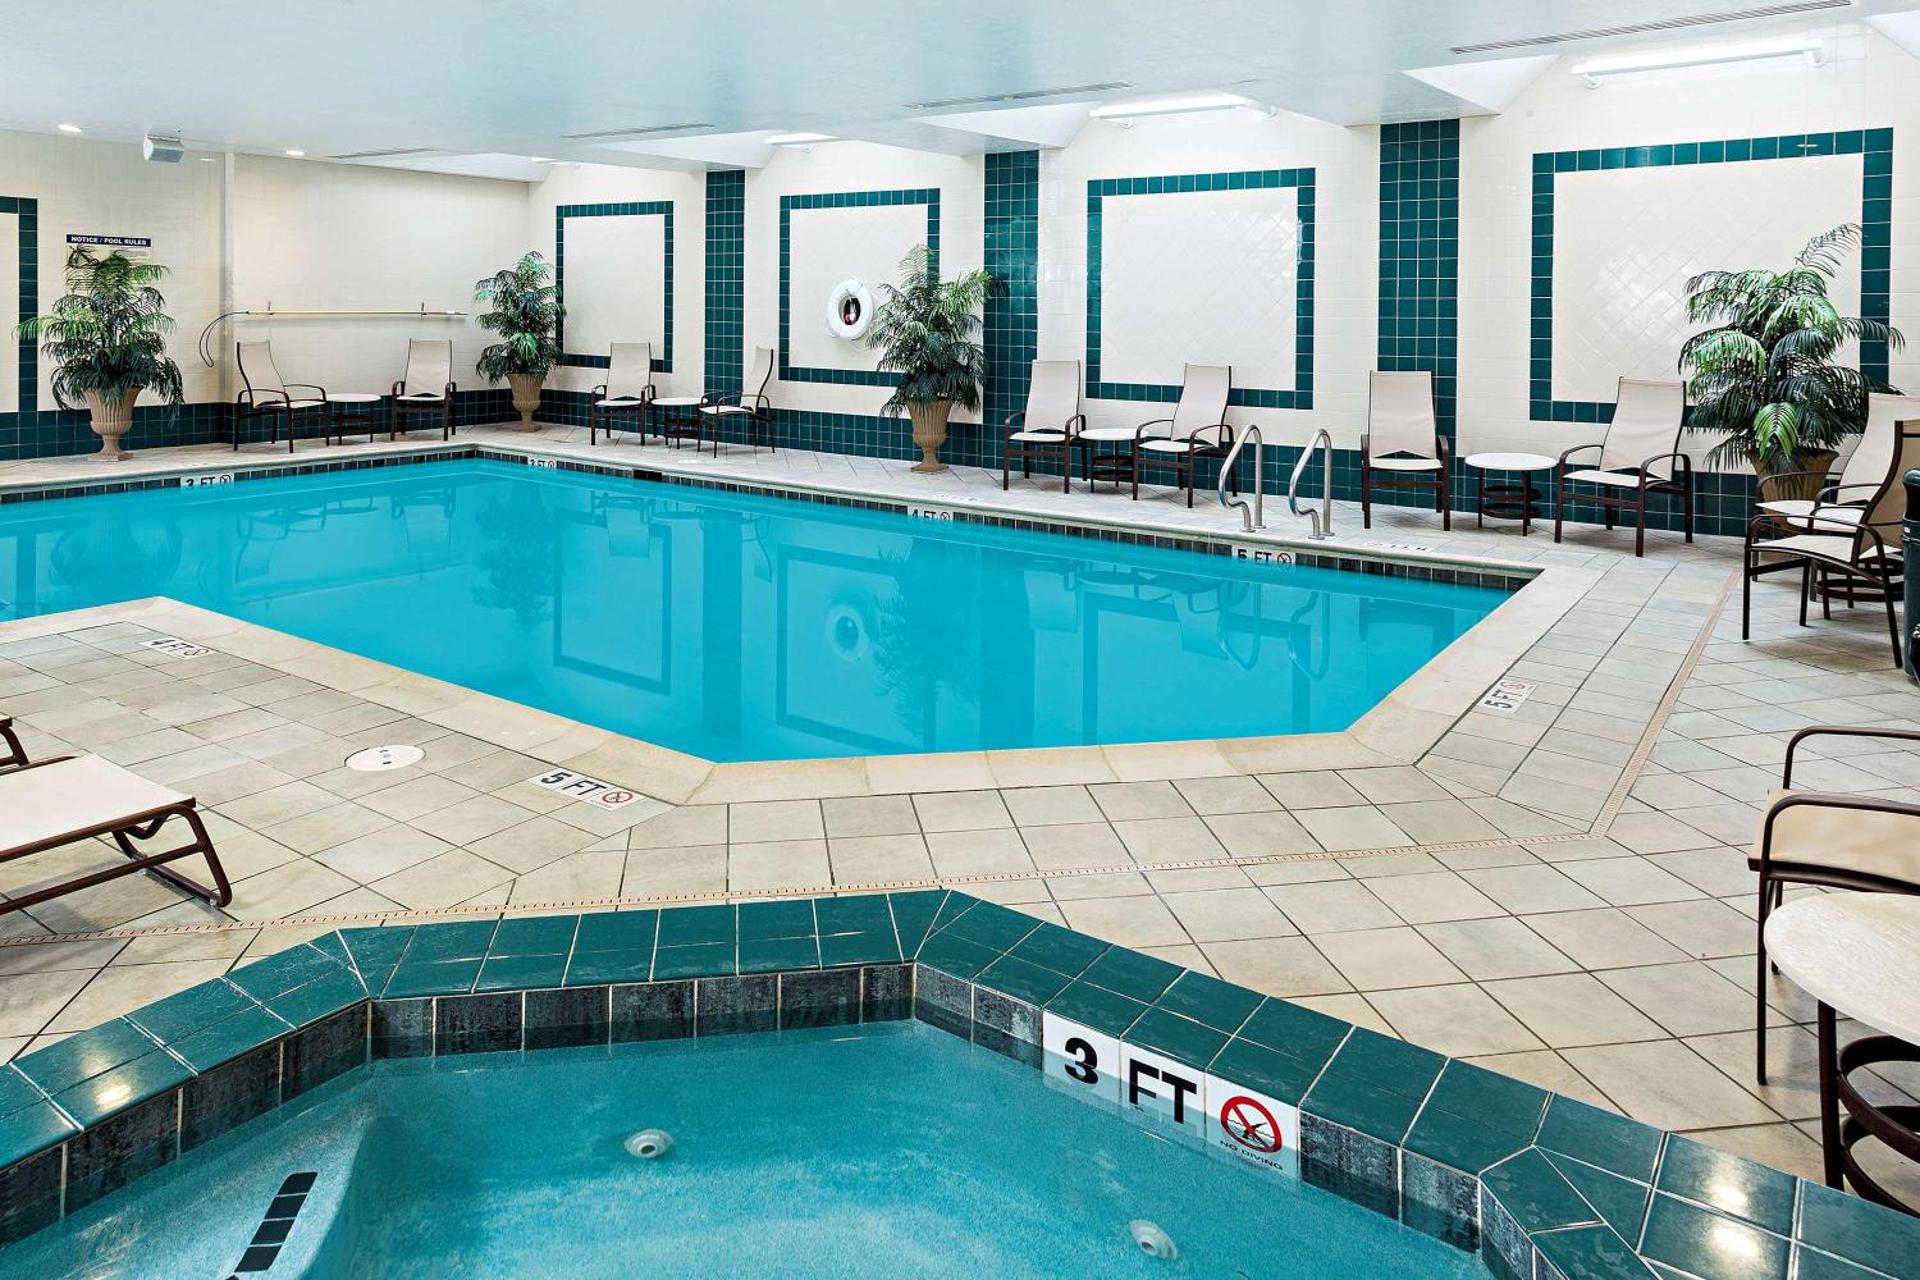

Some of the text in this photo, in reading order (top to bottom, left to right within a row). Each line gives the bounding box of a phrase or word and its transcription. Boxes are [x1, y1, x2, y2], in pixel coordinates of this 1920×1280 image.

[200, 476, 216, 486] FT
[923, 510, 937, 520] FT
[1237, 549, 1272, 561] 5 FT
[1484, 699, 1513, 709] 5
[540, 771, 608, 796] 5 FT
[1064, 1037, 1198, 1125] 3 FT
[1219, 1139, 1284, 1171] NO DIVING
